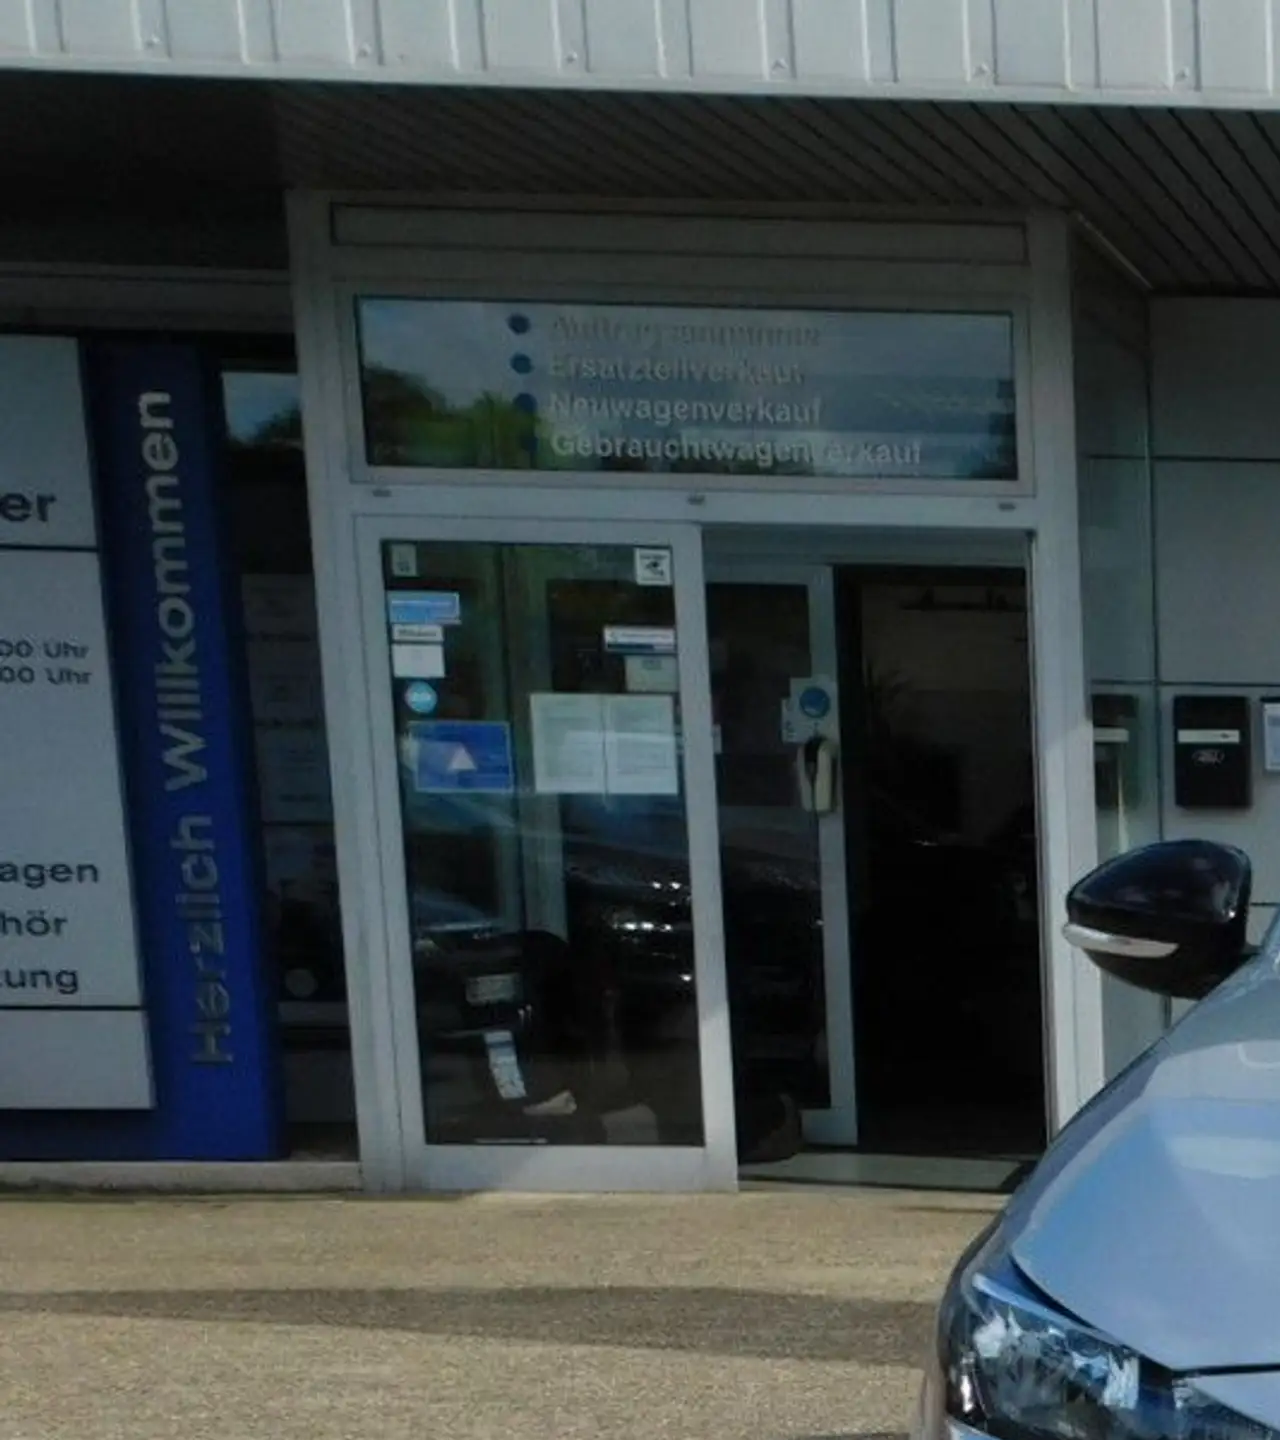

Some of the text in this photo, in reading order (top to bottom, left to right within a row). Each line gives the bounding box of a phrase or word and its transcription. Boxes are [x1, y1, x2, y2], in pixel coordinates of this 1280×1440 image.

[548, 353, 806, 387] Ersatzteilverkauf
[548, 391, 822, 427] Neuwagenverkauf
[549, 430, 921, 469] Gebrauchtwagenverkauf
[43, 640, 90, 660] Uhr
[46, 666, 93, 686] Uhr
[137, 388, 234, 1067] Herzlich Willkommen
[0, 967, 79, 995] ung
